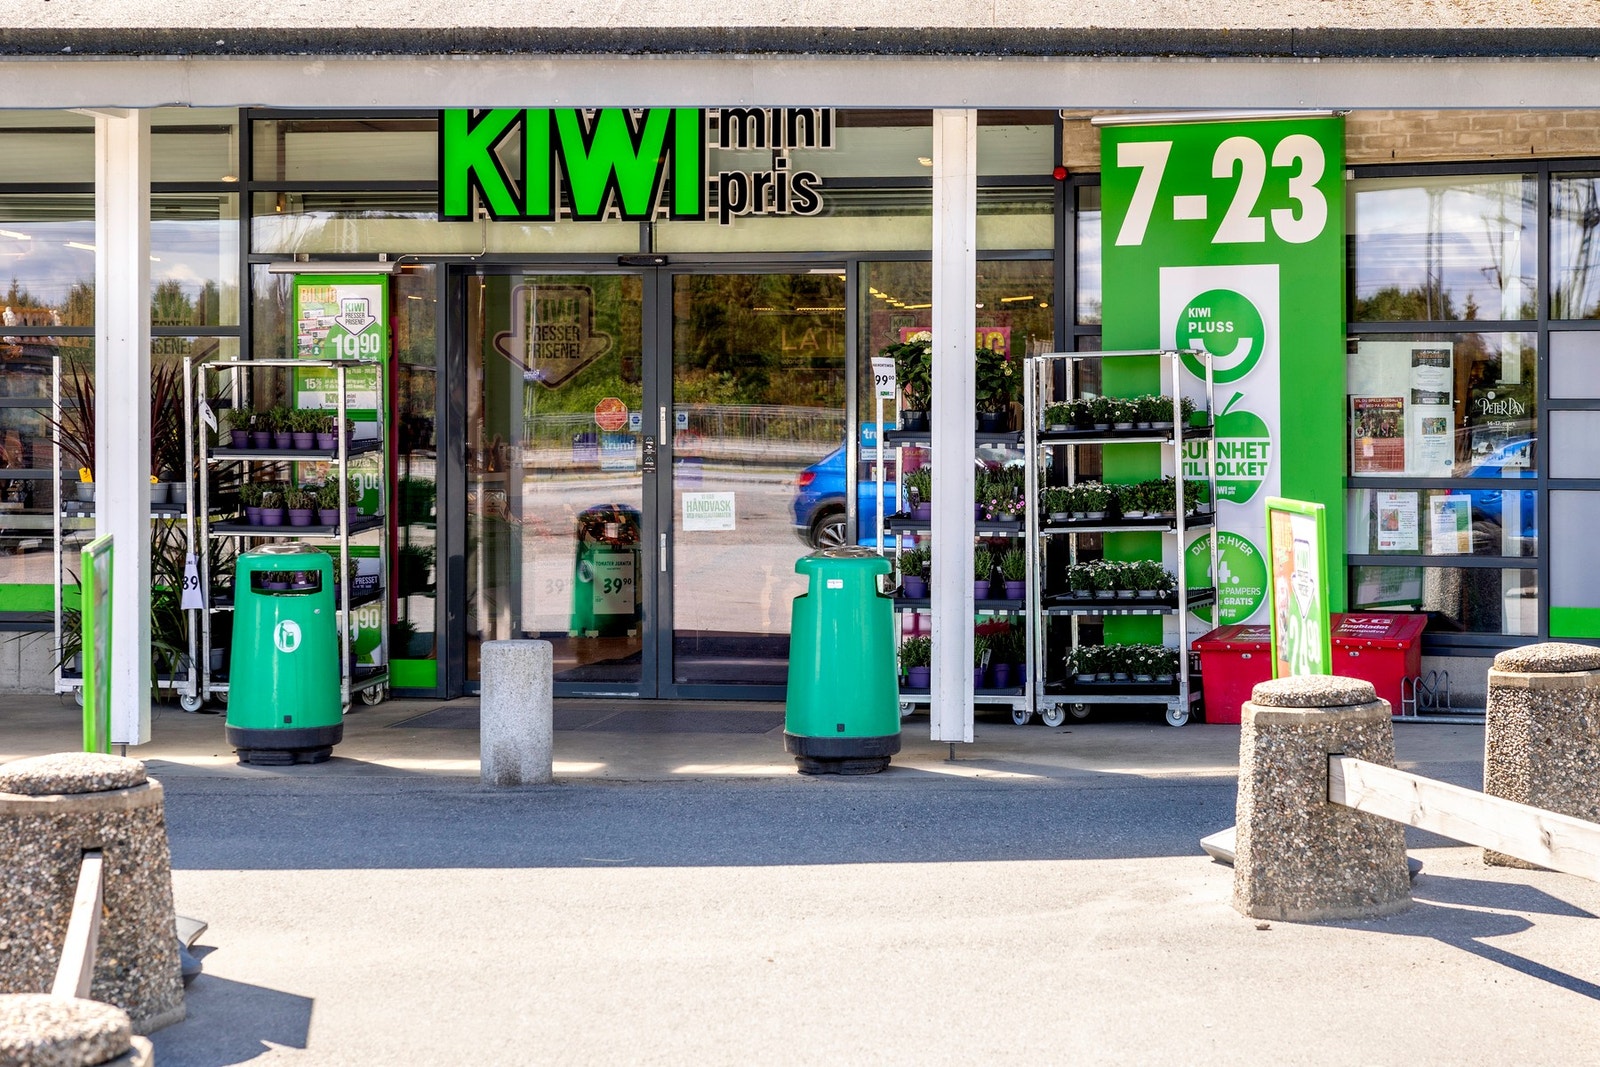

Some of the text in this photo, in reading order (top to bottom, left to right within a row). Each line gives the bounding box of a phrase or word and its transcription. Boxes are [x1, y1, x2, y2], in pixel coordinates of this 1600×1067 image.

[437, 108, 835, 222] KIWI mini
[718, 157, 823, 226] pris
[1115, 134, 1328, 246] 7-23
[301, 287, 337, 303] BILLIG
[345, 302, 365, 311] KIWI
[1188, 307, 1211, 317] KIWI
[525, 325, 581, 341] PRESSER
[1188, 321, 1234, 333] PLUSS
[525, 342, 581, 359] PRISENE!
[875, 374, 889, 386] 99
[602, 439, 635, 450] trumf
[686, 498, 731, 512] HÅNDVASK
[1191, 541, 1207, 556] DU
[1226, 536, 1254, 556] HVER
[603, 577, 632, 594] 39 90
[1225, 587, 1261, 595] PAMPERS
[1224, 597, 1254, 605] GRATIS
